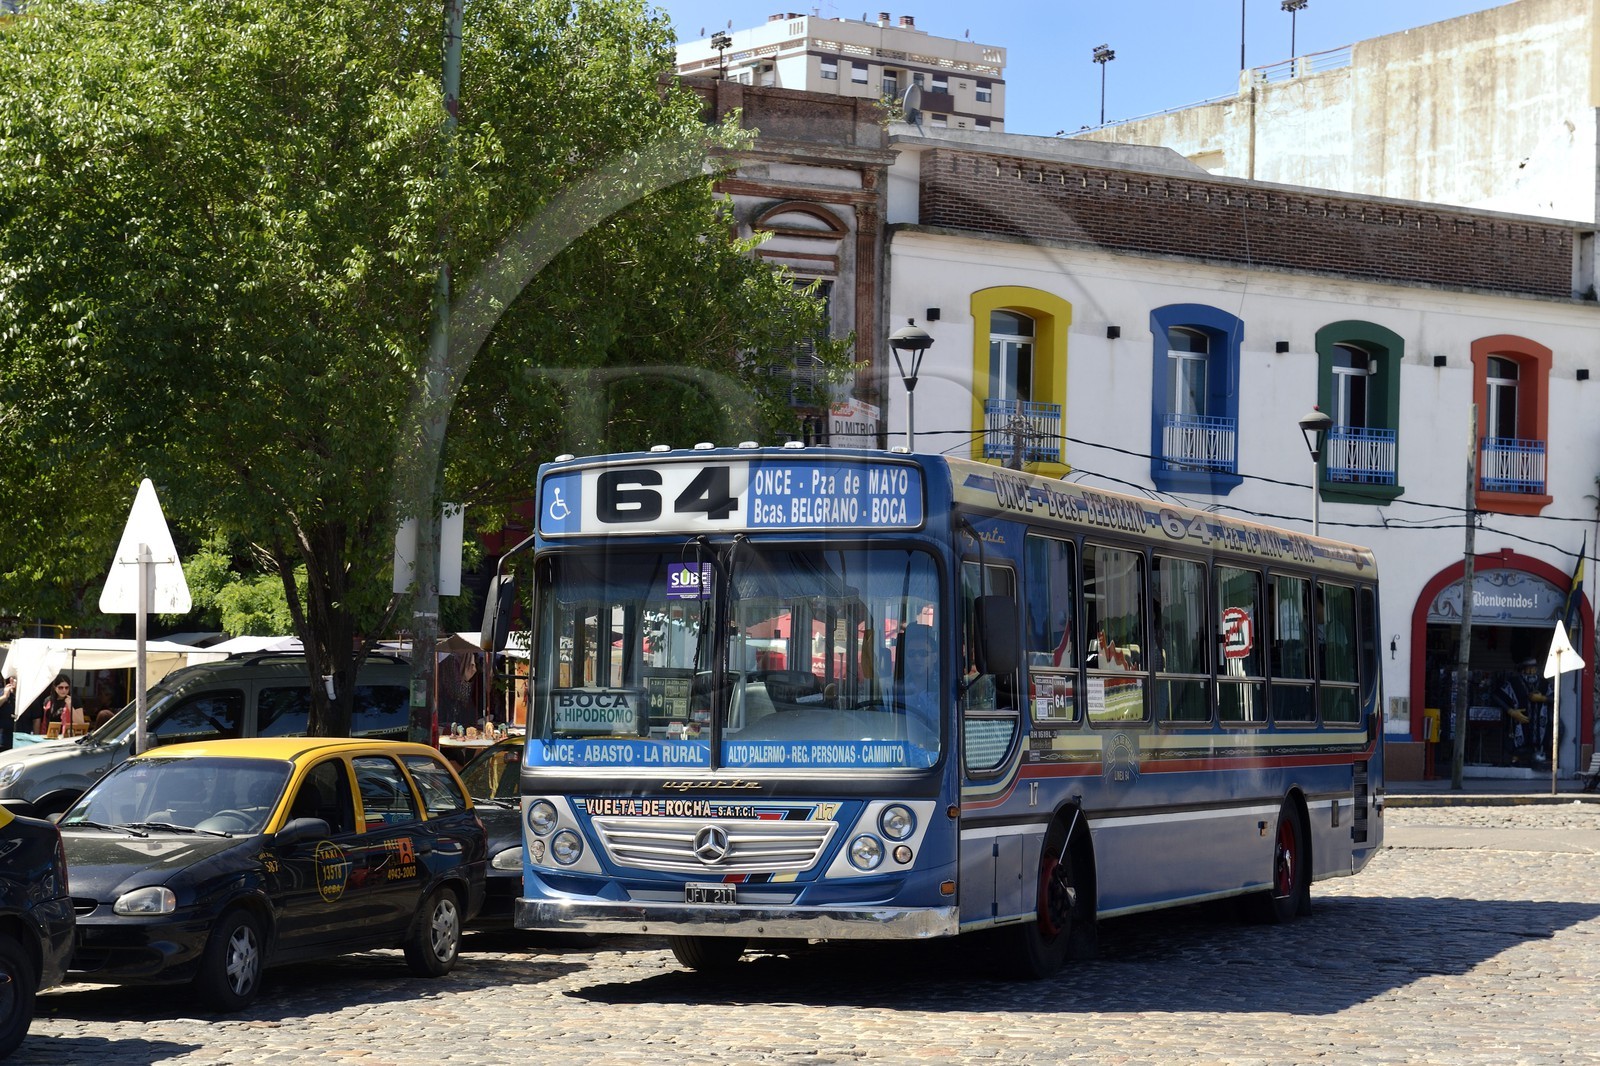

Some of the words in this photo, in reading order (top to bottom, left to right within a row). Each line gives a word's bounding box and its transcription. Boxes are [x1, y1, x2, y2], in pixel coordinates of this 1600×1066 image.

[755, 469, 792, 495] ONCE
[812, 469, 835, 495] Pza
[844, 469, 860, 495] de
[869, 469, 908, 495] MAYO
[596, 466, 739, 523] 64
[754, 498, 786, 524] Bcas.
[791, 497, 858, 524] BELGRANO
[871, 498, 907, 524] BOCA
[993, 471, 1034, 513] ONCE
[1043, 483, 1083, 522] Bcas.
[1082, 491, 1147, 534] BELGRANO
[1159, 508, 1213, 545] 64
[1243, 525, 1257, 554] de
[1257, 529, 1283, 558] MAYO
[1289, 534, 1315, 562] BOCA
[671, 568, 708, 585] SUBE
[1472, 590, 1538, 608] Bienvenidos!
[559, 693, 630, 708] BOCA
[1055, 694, 1065, 708] 64
[565, 708, 633, 723] HIPODROMO
[543, 744, 575, 762] ONCE
[584, 745, 633, 762] ABASTO
[644, 745, 659, 763] LA
[662, 745, 704, 763] RURAL
[728, 745, 748, 763] ALTO
[749, 745, 785, 763] PALERMO
[791, 745, 810, 763] REG.
[811, 745, 856, 763] PERSONAS
[862, 745, 903, 763] CAMINITO
[662, 778, 762, 792] ugarte
[1029, 782, 1039, 806] 17
[585, 799, 636, 815] VUELTA
[641, 799, 660, 815] DE
[665, 800, 712, 817] ROCHA
[717, 806, 758, 817] S.A.T.C.I.
[815, 803, 836, 820] 17
[384, 839, 399, 850] FREE
[319, 849, 338, 859] TAXI
[387, 865, 417, 881] 4943-2003
[323, 884, 341, 894] GCBA
[687, 889, 707, 903] JFV
[714, 889, 734, 903] 211
